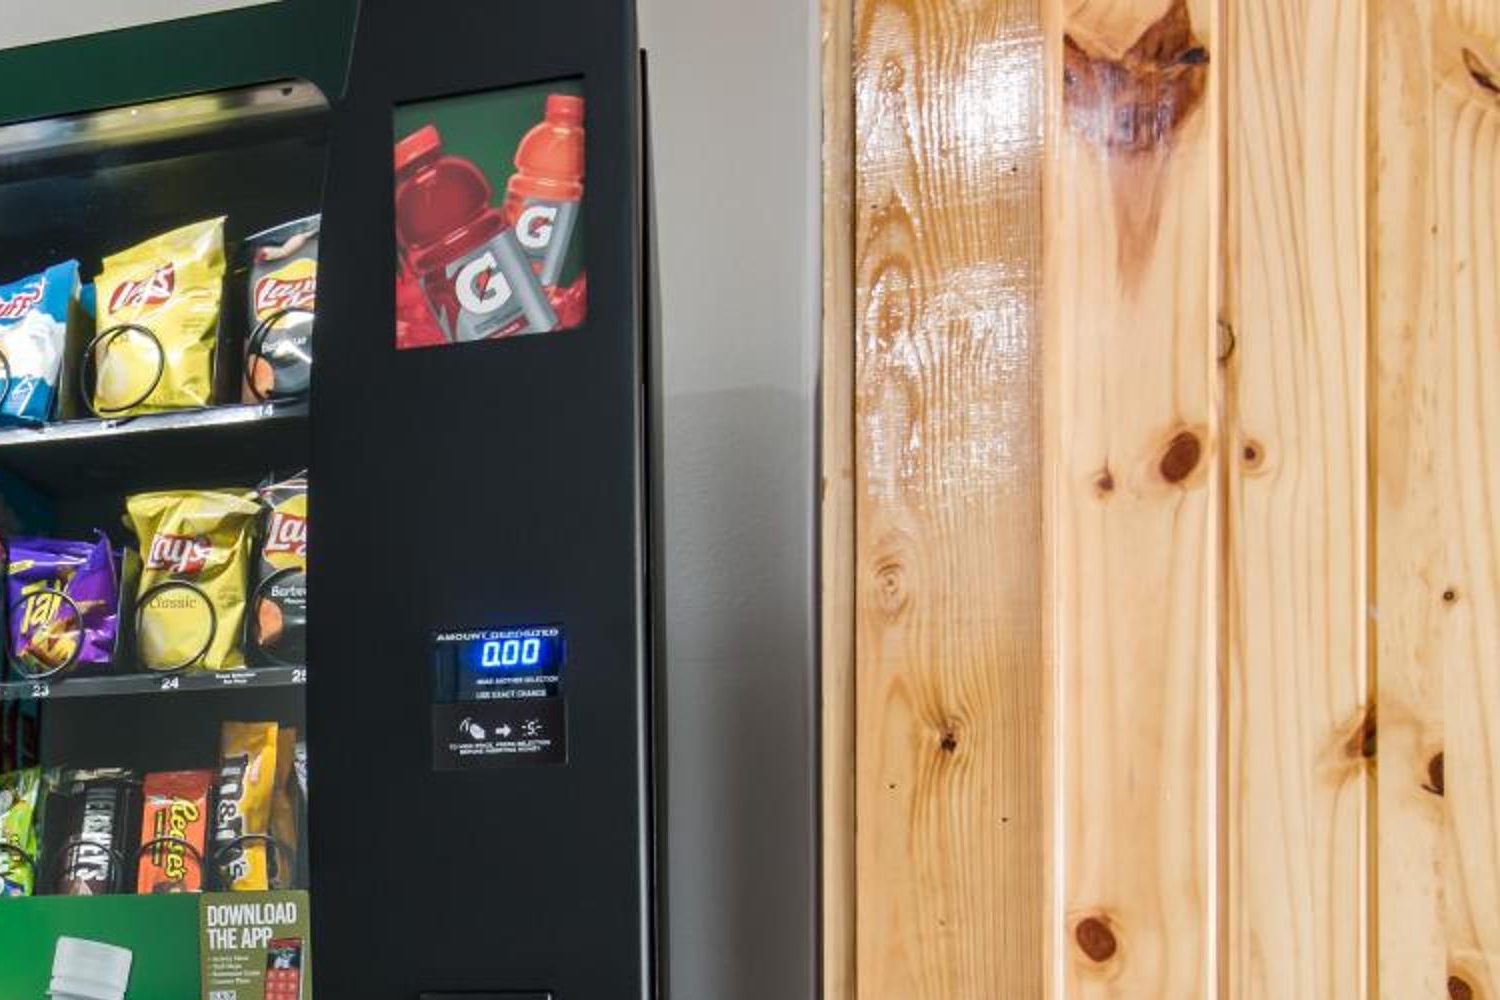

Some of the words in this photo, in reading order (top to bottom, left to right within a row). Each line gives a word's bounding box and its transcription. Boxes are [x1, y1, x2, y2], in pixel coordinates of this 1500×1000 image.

[150, 596, 197, 609] Classic
[166, 796, 199, 881] Reese's
[207, 902, 297, 927] DOWNLOAD
[207, 928, 237, 949] THE
[241, 927, 273, 949] APP
